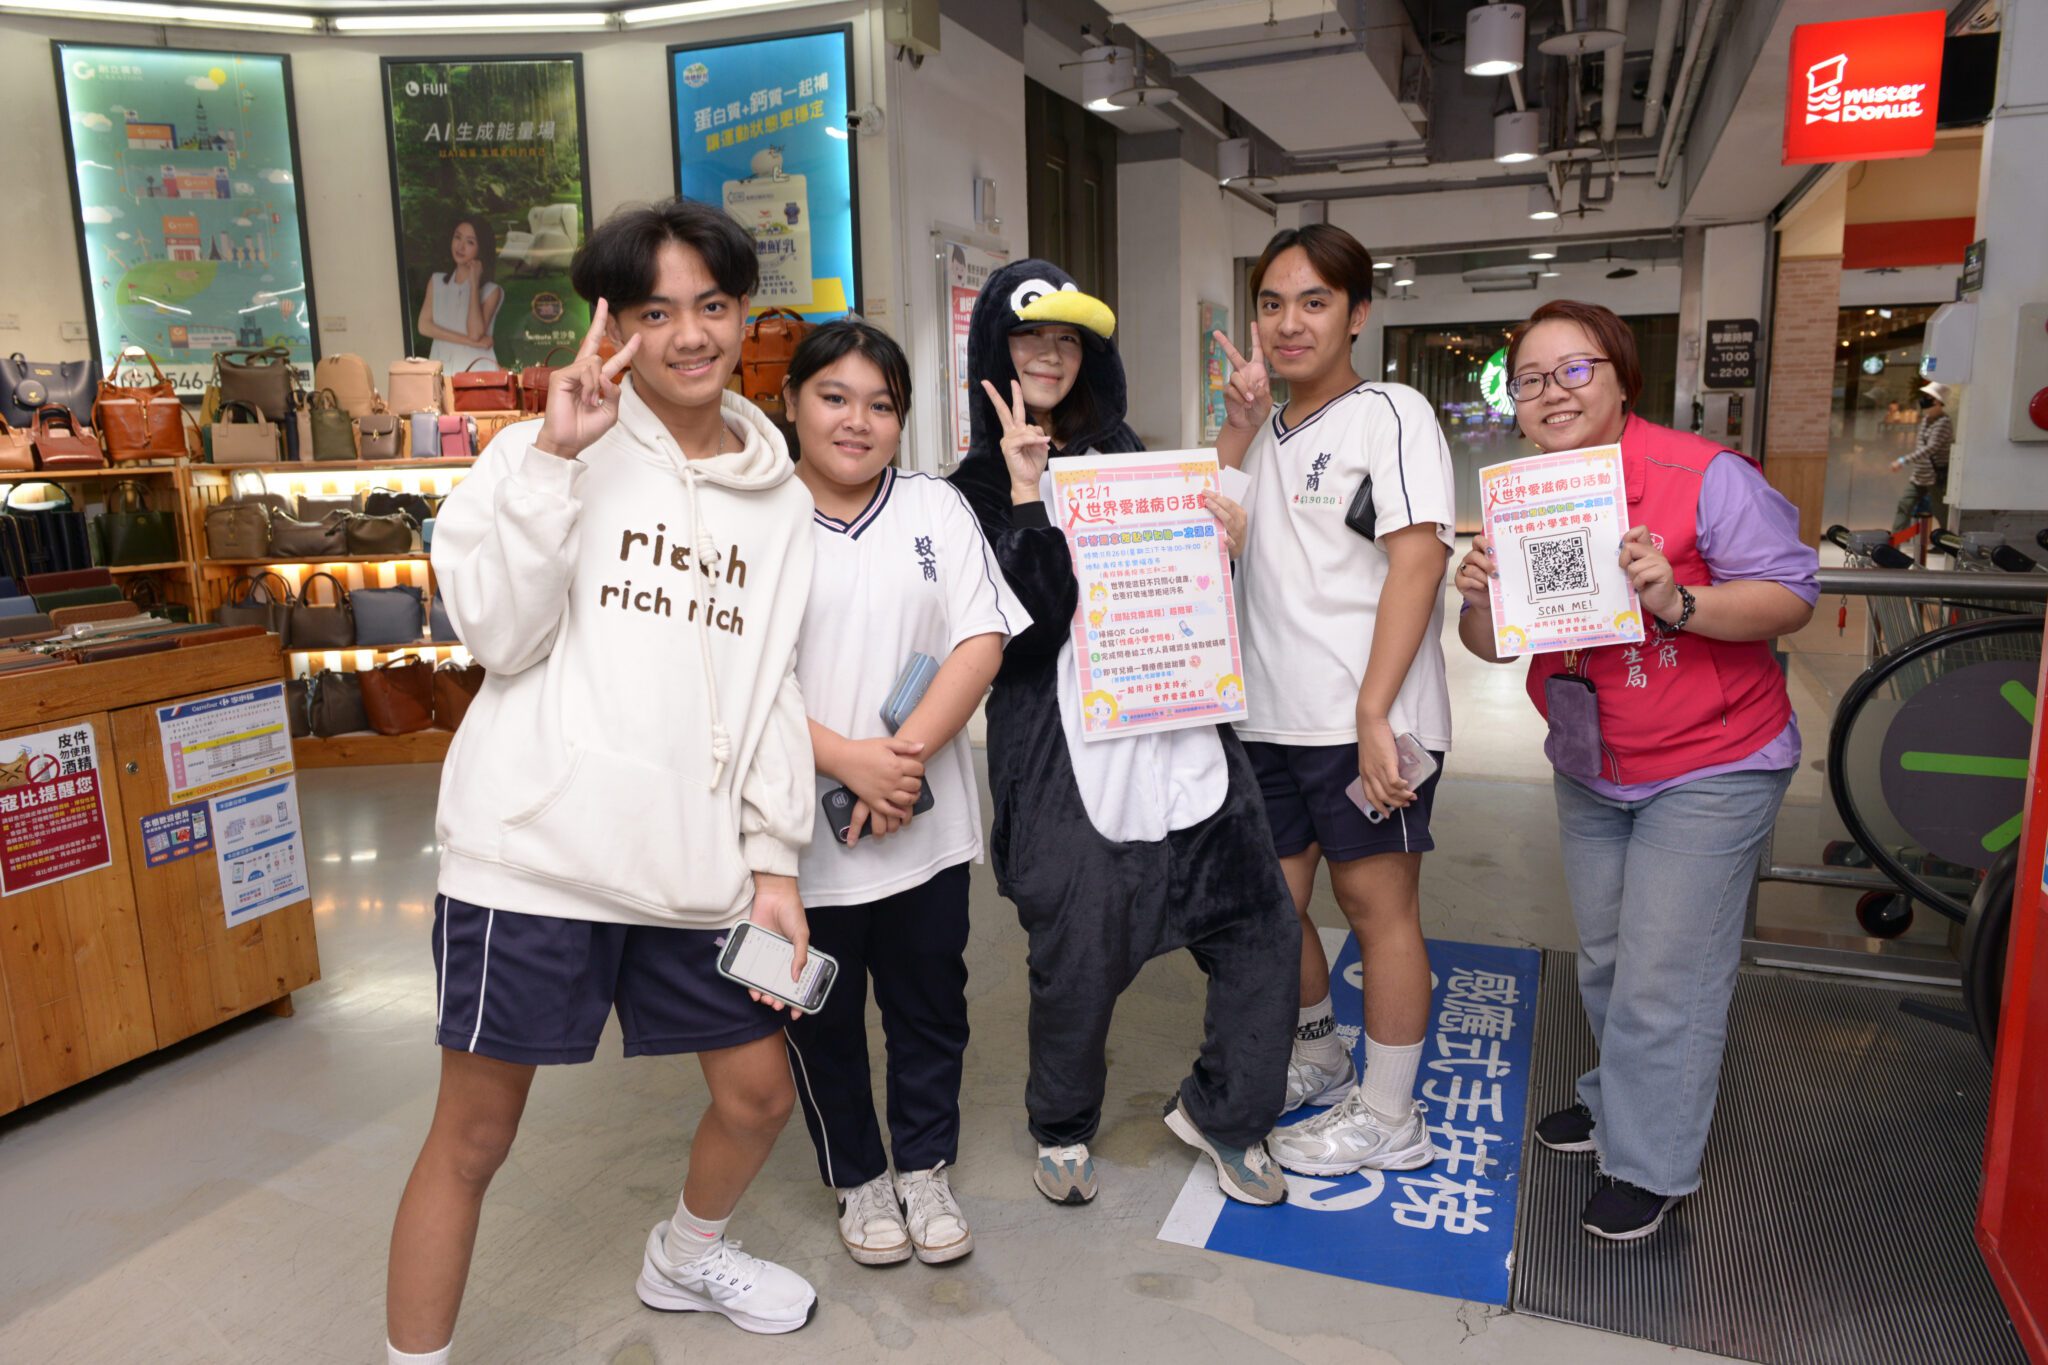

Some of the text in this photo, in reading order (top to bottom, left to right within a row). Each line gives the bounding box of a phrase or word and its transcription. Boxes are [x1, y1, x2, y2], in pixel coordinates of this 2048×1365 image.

[423, 83, 448, 97] FUJI
[1844, 84, 1925, 104] mister
[694, 72, 829, 133] 蛋白質+鈣質一起補
[1842, 102, 1924, 122] Donut
[706, 100, 825, 153] 讓運動狀態更穩定
[1711, 331, 1753, 345] 營業時間
[1720, 352, 1750, 362] 10:00
[1720, 367, 1749, 378] 22:00
[1495, 476, 1521, 489] 12/1
[1502, 473, 1611, 500] 世界愛滋病日活動
[1076, 485, 1111, 501] 12/1
[1087, 494, 1210, 518] 世界愛滋病日活動
[600, 580, 744, 636] rich rich
[1538, 600, 1593, 616] SCAN ME!
[1129, 626, 1150, 636] Code
[1153, 690, 1205, 703] 世界愛滋病日
[58, 730, 88, 749] 皮件
[60, 745, 90, 760] 勿使用
[62, 756, 92, 777] 酒精
[0, 776, 94, 814] 寇比提醒您
[1391, 967, 1520, 1235] 感應式手扶梯
